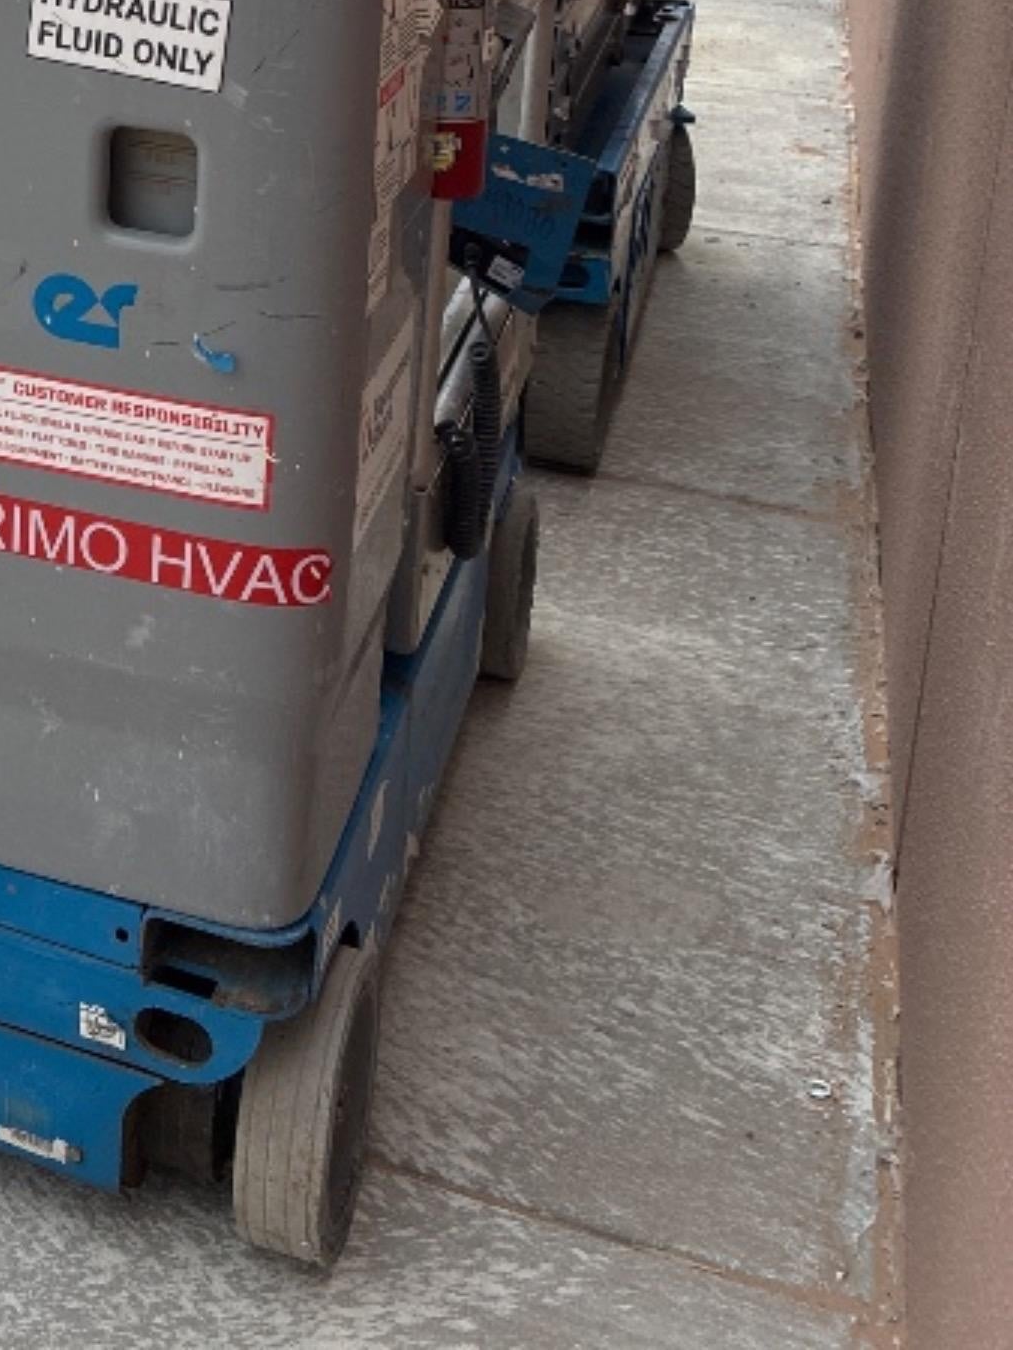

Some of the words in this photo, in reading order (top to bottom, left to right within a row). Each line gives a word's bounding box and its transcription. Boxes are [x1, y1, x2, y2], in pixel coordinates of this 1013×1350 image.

[38, 20, 123, 59] FLUID
[133, 38, 215, 76] ONLY
[13, 381, 107, 412] CUSTOMER
[112, 400, 264, 439] RESPONSIBILITY
[150, 534, 331, 605] HVAC
